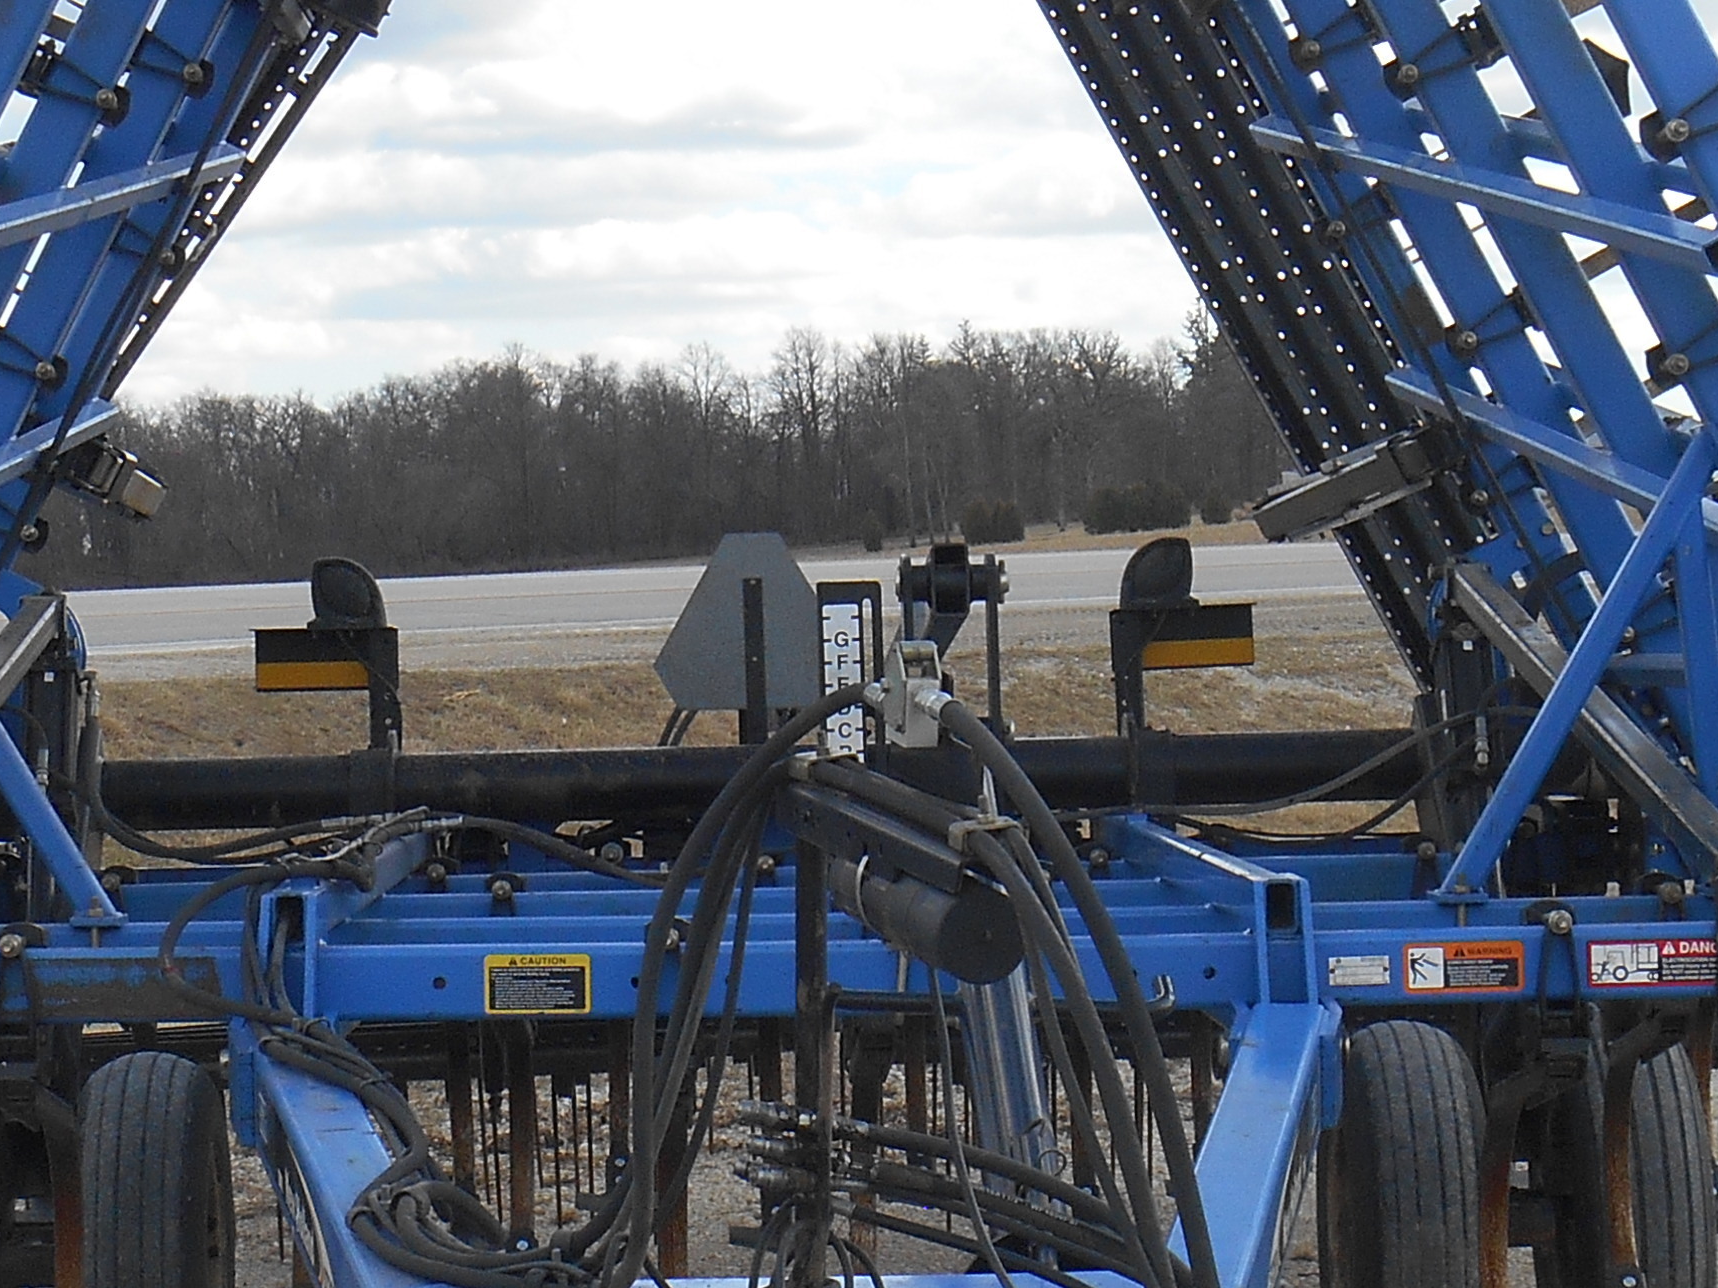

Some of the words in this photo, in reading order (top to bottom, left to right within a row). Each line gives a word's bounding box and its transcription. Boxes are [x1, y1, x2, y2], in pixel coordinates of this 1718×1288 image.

[834, 631, 849, 648] G
[837, 654, 848, 670] F
[838, 722, 852, 739] C
[1679, 941, 1718, 954] DANG
[520, 957, 567, 965] CAUTION
